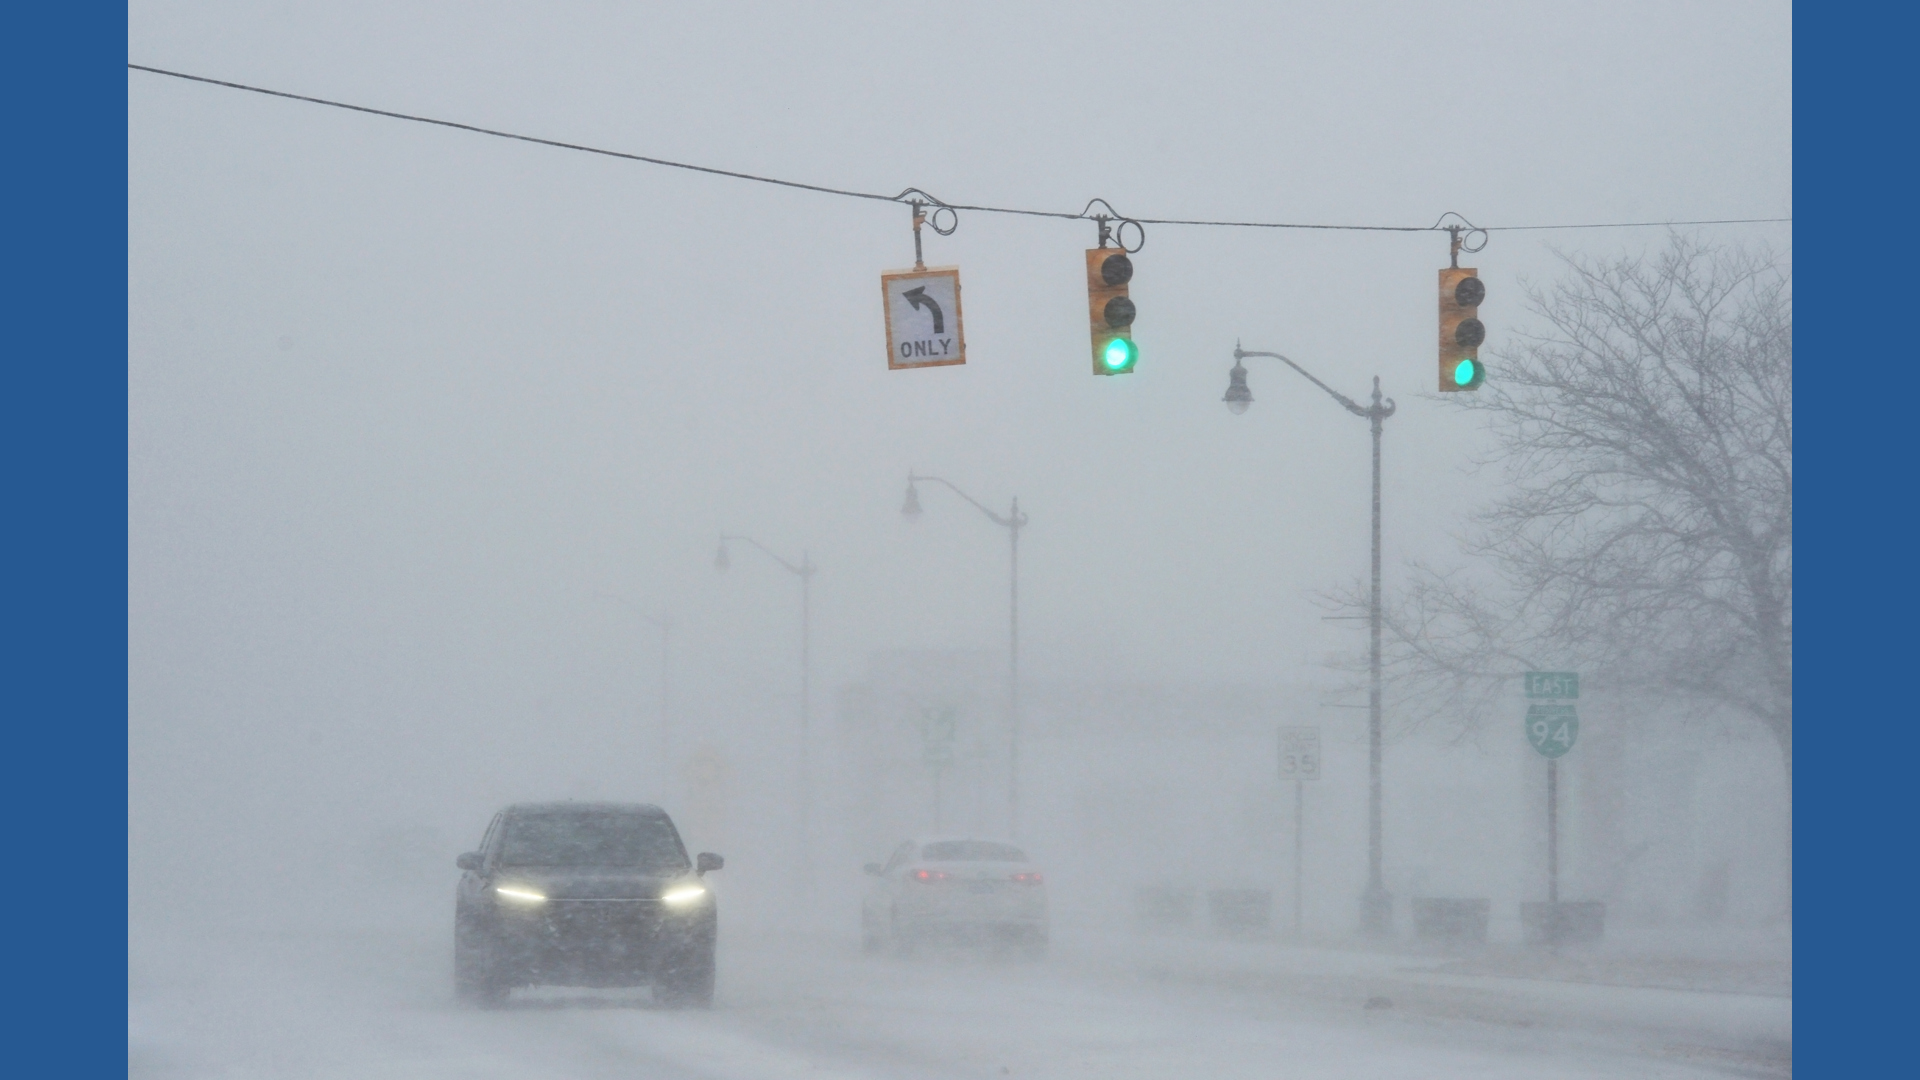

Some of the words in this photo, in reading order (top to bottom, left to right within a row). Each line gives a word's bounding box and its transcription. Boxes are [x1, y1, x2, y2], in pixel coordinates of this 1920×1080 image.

[900, 338, 952, 358] ONLY
[1532, 675, 1573, 695] EAST
[1532, 720, 1571, 748] 94
[1283, 754, 1317, 775] 35
